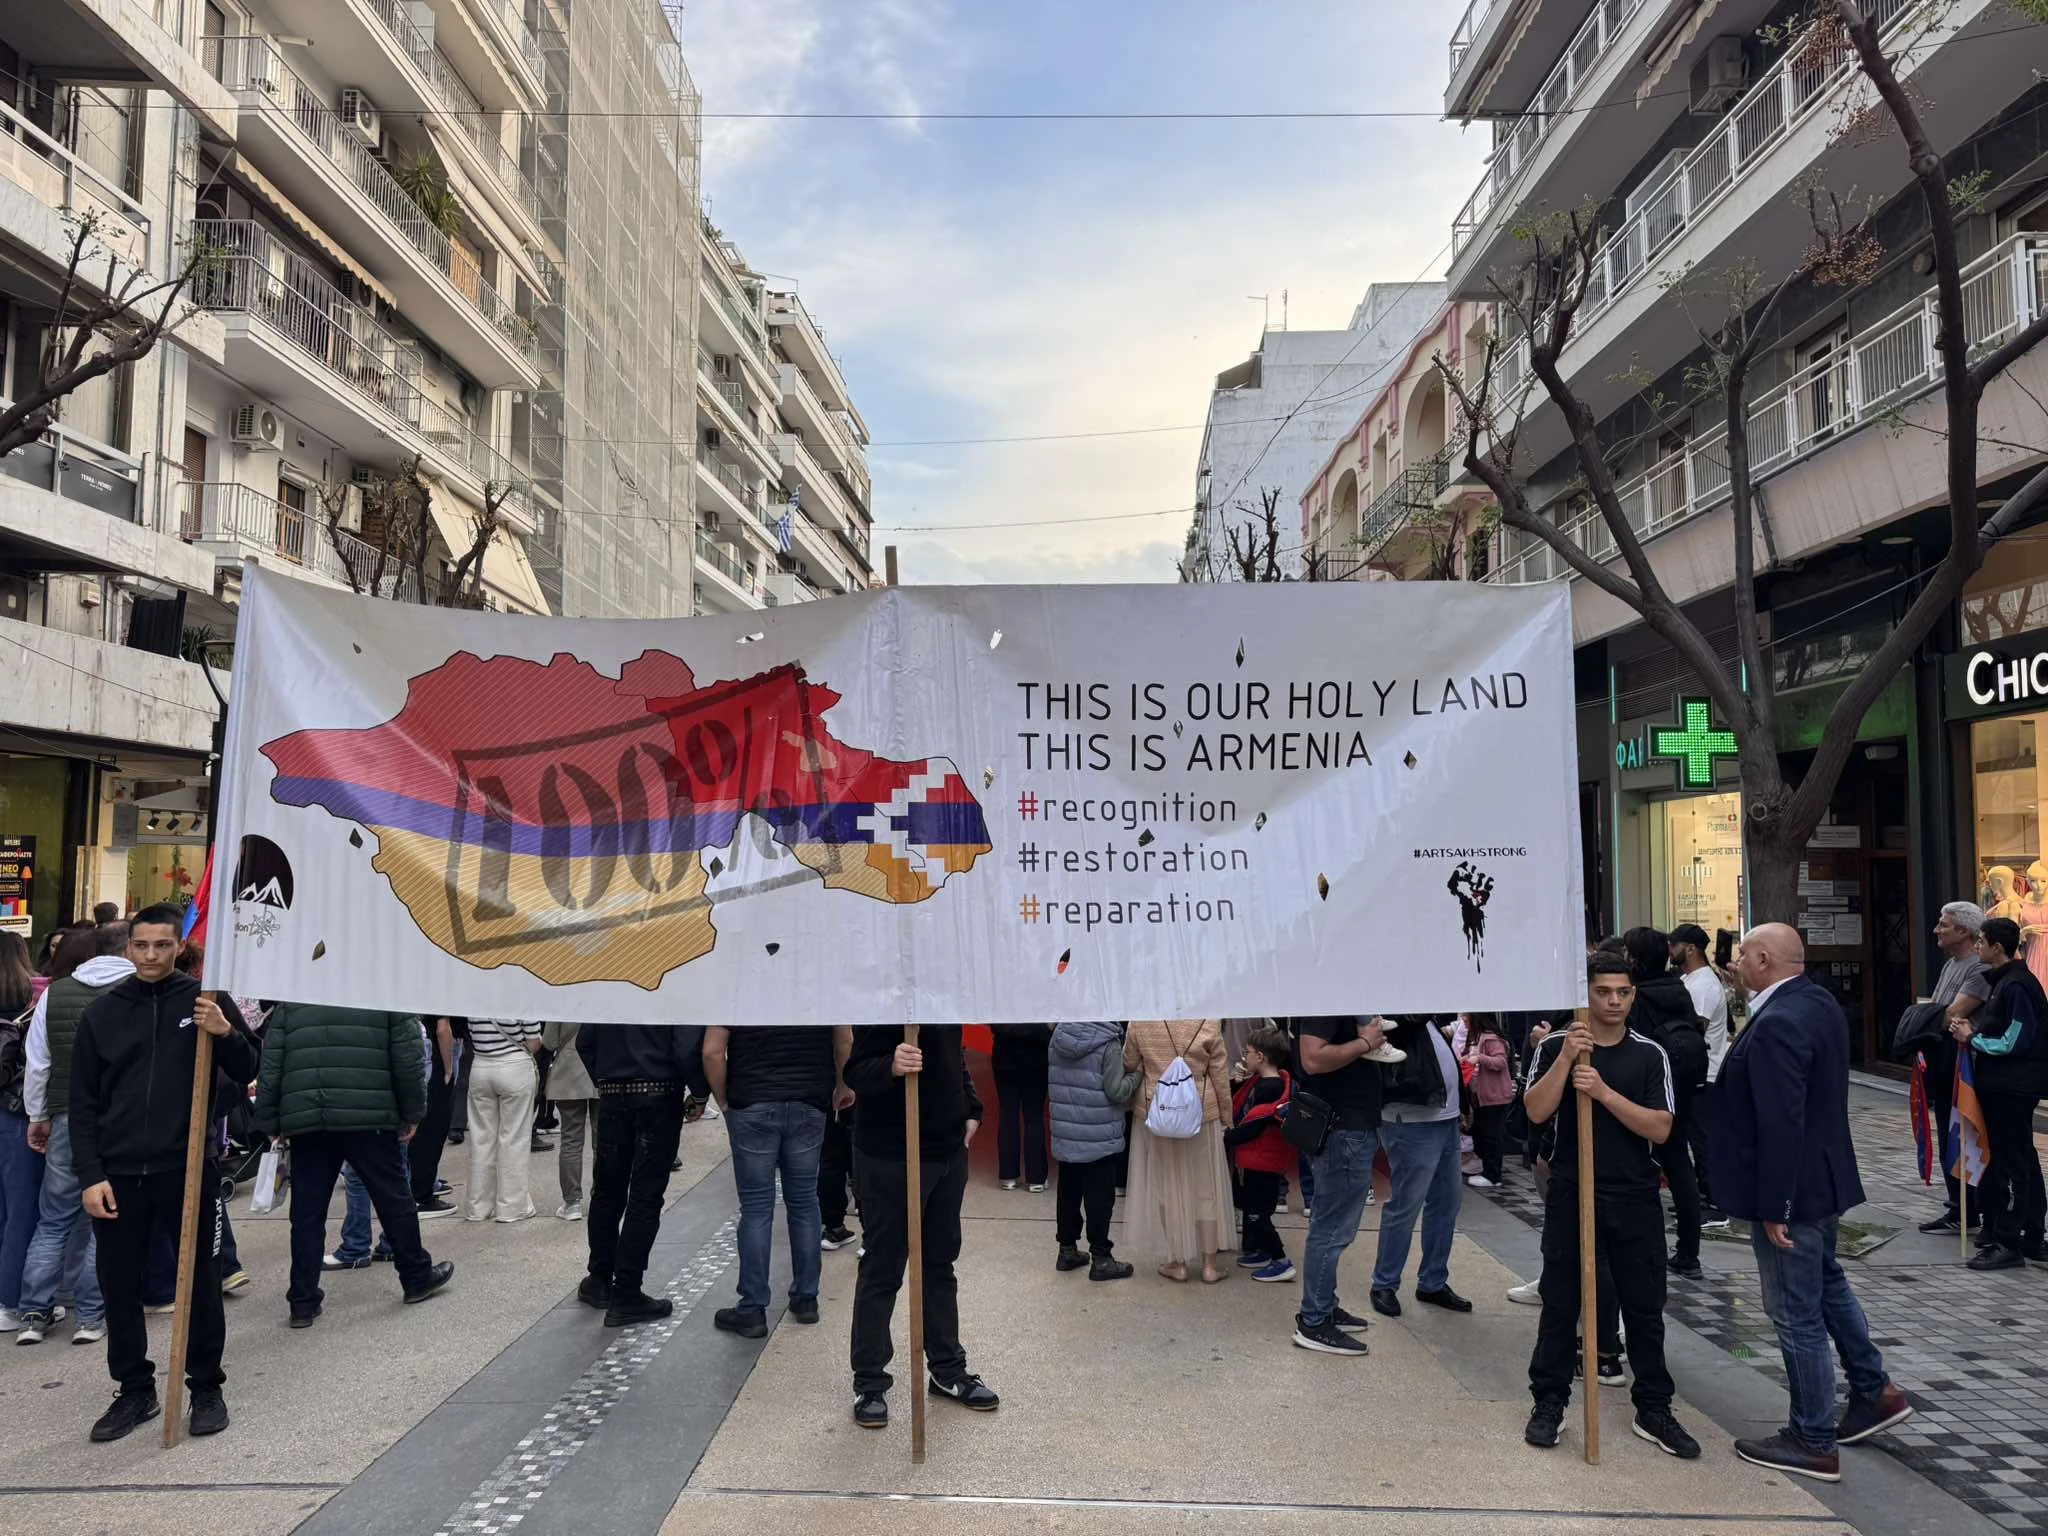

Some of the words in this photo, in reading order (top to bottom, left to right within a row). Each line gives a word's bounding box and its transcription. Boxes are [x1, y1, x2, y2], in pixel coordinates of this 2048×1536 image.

[1017, 682, 1111, 720] THIS
[1132, 682, 1167, 720] IS
[1187, 682, 1270, 720] OUR
[1289, 680, 1396, 719] HOLY
[1413, 671, 1528, 716] LAND
[1017, 733, 1111, 771] THIS
[1131, 733, 1167, 771] IS
[1187, 731, 1373, 771] ARMENIA
[472, 706, 795, 922] 100%
[1018, 791, 1236, 830] #recognition
[1018, 842, 1248, 874] #restoration
[1413, 847, 1527, 858] #ARTSAKHSTRONG
[1019, 892, 1235, 932] #reparation
